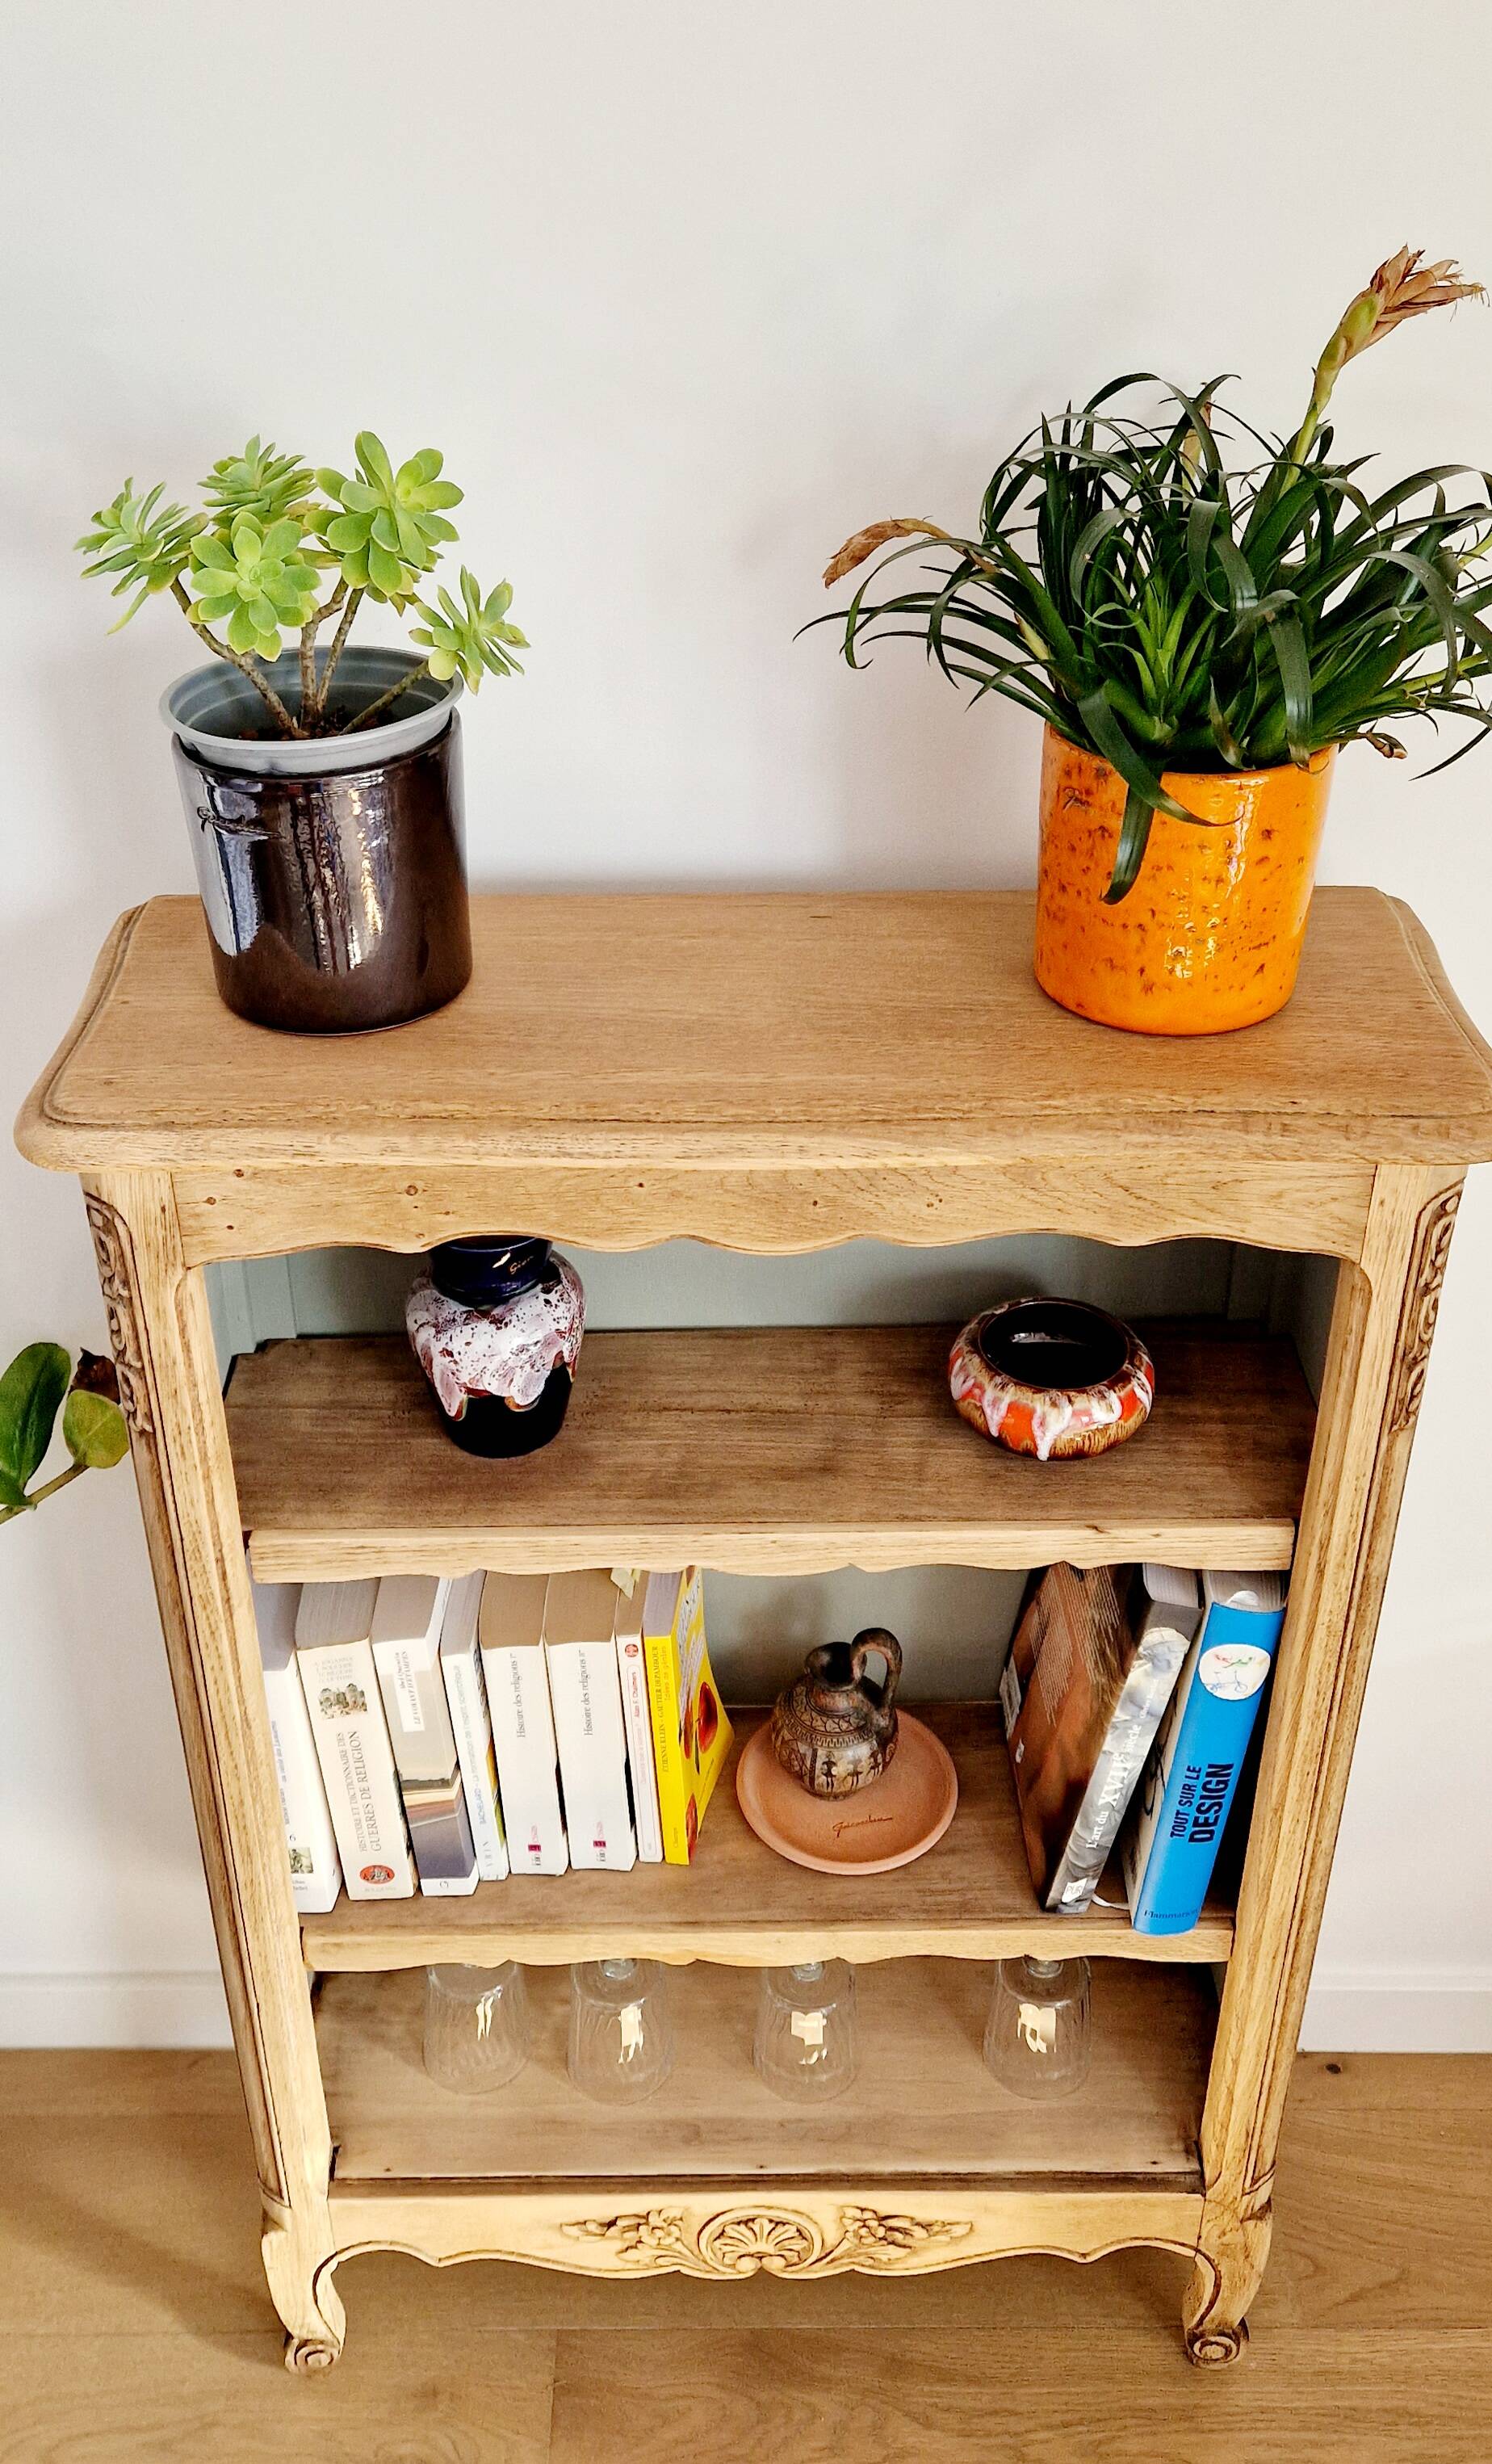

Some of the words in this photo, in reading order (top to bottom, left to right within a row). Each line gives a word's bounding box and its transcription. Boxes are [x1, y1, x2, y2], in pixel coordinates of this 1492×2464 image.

[509, 1660, 523, 1693] religions
[578, 1659, 592, 1691] religions
[652, 1646, 662, 1687] DEPAMBOUR
[513, 1694, 523, 1707] des
[580, 1693, 590, 1706] des
[655, 1689, 664, 1719] GAUTIER
[515, 1709, 526, 1739] Histoire
[583, 1707, 594, 1737] Histoire
[658, 1724, 666, 1744] KLEIN
[336, 1732, 346, 1748] DES
[347, 1730, 368, 1783] RELIGION
[340, 1749, 358, 1805] DICTIONNAIRE
[1085, 1824, 1104, 1849] L'art
[1095, 1811, 1109, 1825] du
[1125, 1724, 1142, 1753] siècle
[1187, 1765, 1202, 1781] LE
[358, 1786, 372, 1800] DE
[1179, 1784, 1197, 1808] SUR
[1188, 1762, 1234, 1844] DESIGN
[350, 1807, 360, 1816] ET
[1170, 1811, 1190, 1839] TOUT
[354, 1818, 367, 1853] HISTOIRE
[362, 1803, 382, 1852] GUERRES
